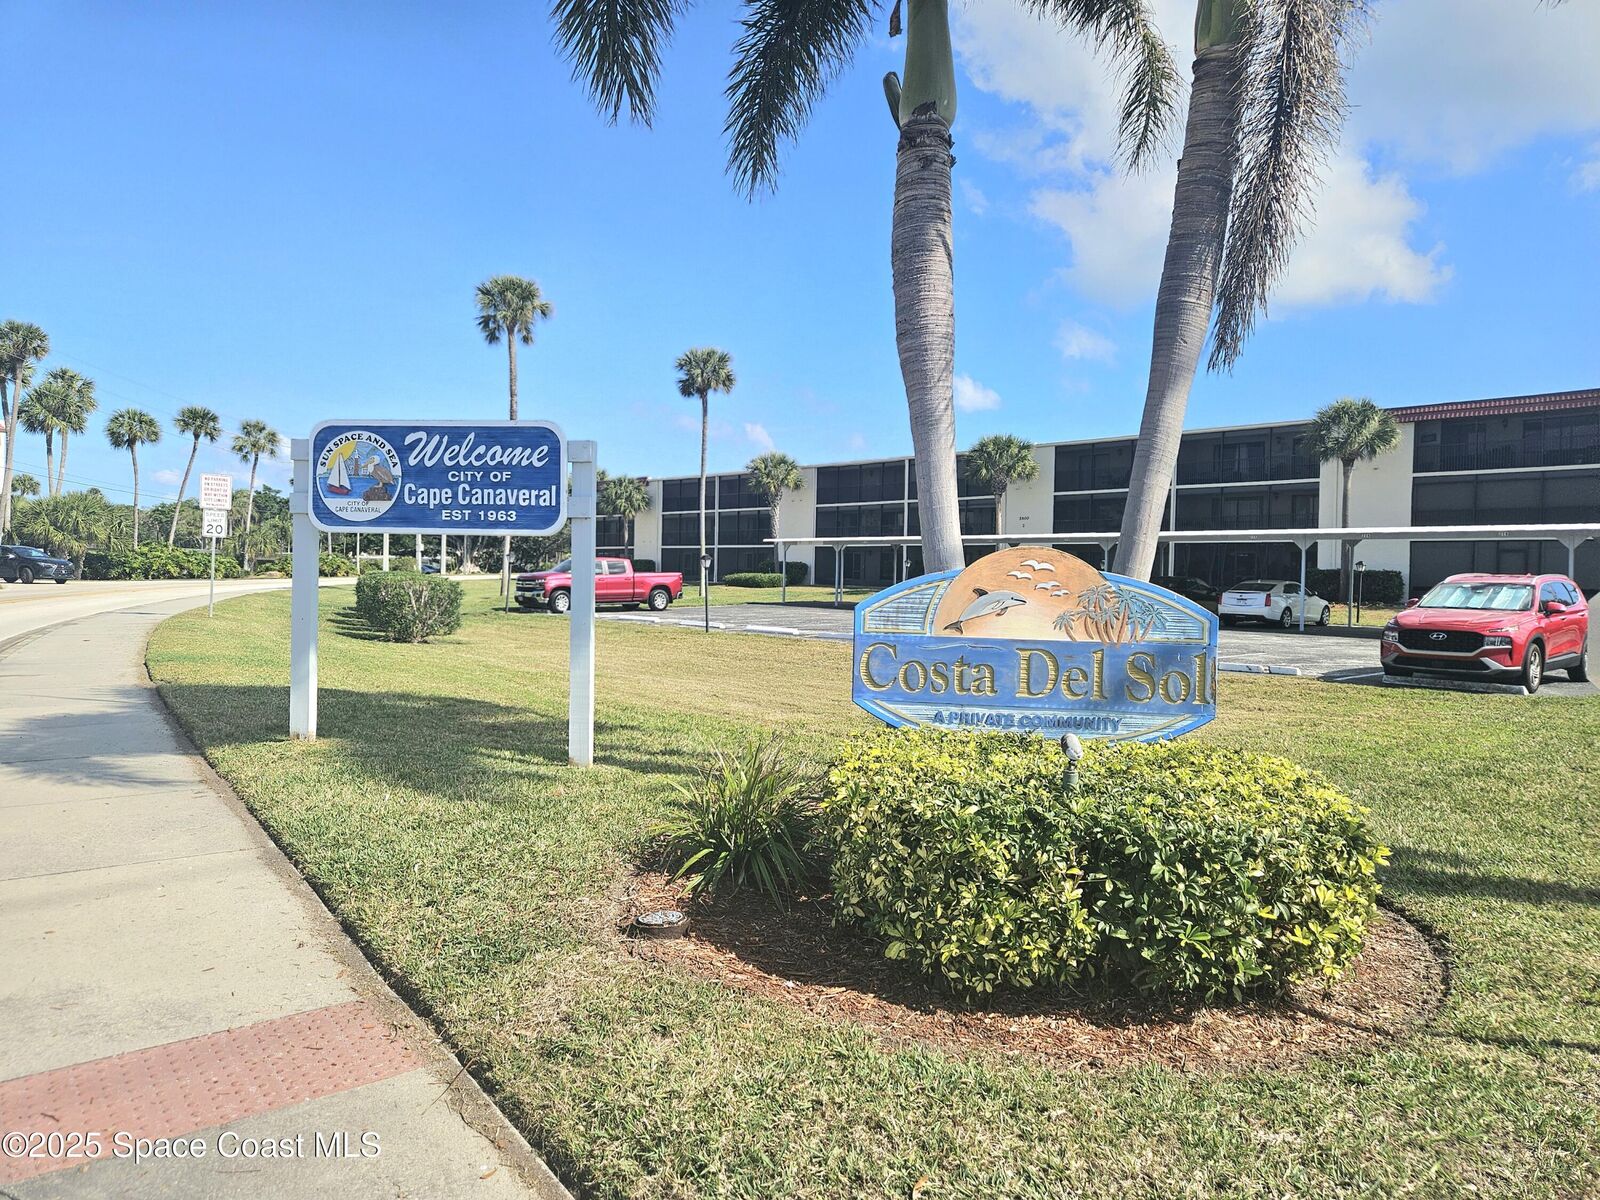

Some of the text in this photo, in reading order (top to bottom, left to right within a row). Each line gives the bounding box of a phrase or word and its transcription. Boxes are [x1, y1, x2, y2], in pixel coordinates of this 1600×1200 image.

[320, 433, 399, 468] SUN SPACE AND SEA
[404, 431, 549, 468] Welcome
[448, 472, 512, 482] CITY OF
[403, 483, 556, 509] Cape Canaveral
[442, 510, 517, 521] EST 1963
[206, 524, 223, 534] 20
[859, 641, 1212, 705] Costa Del Sol
[932, 710, 1124, 732] A PRIVATE COMMUNITY
